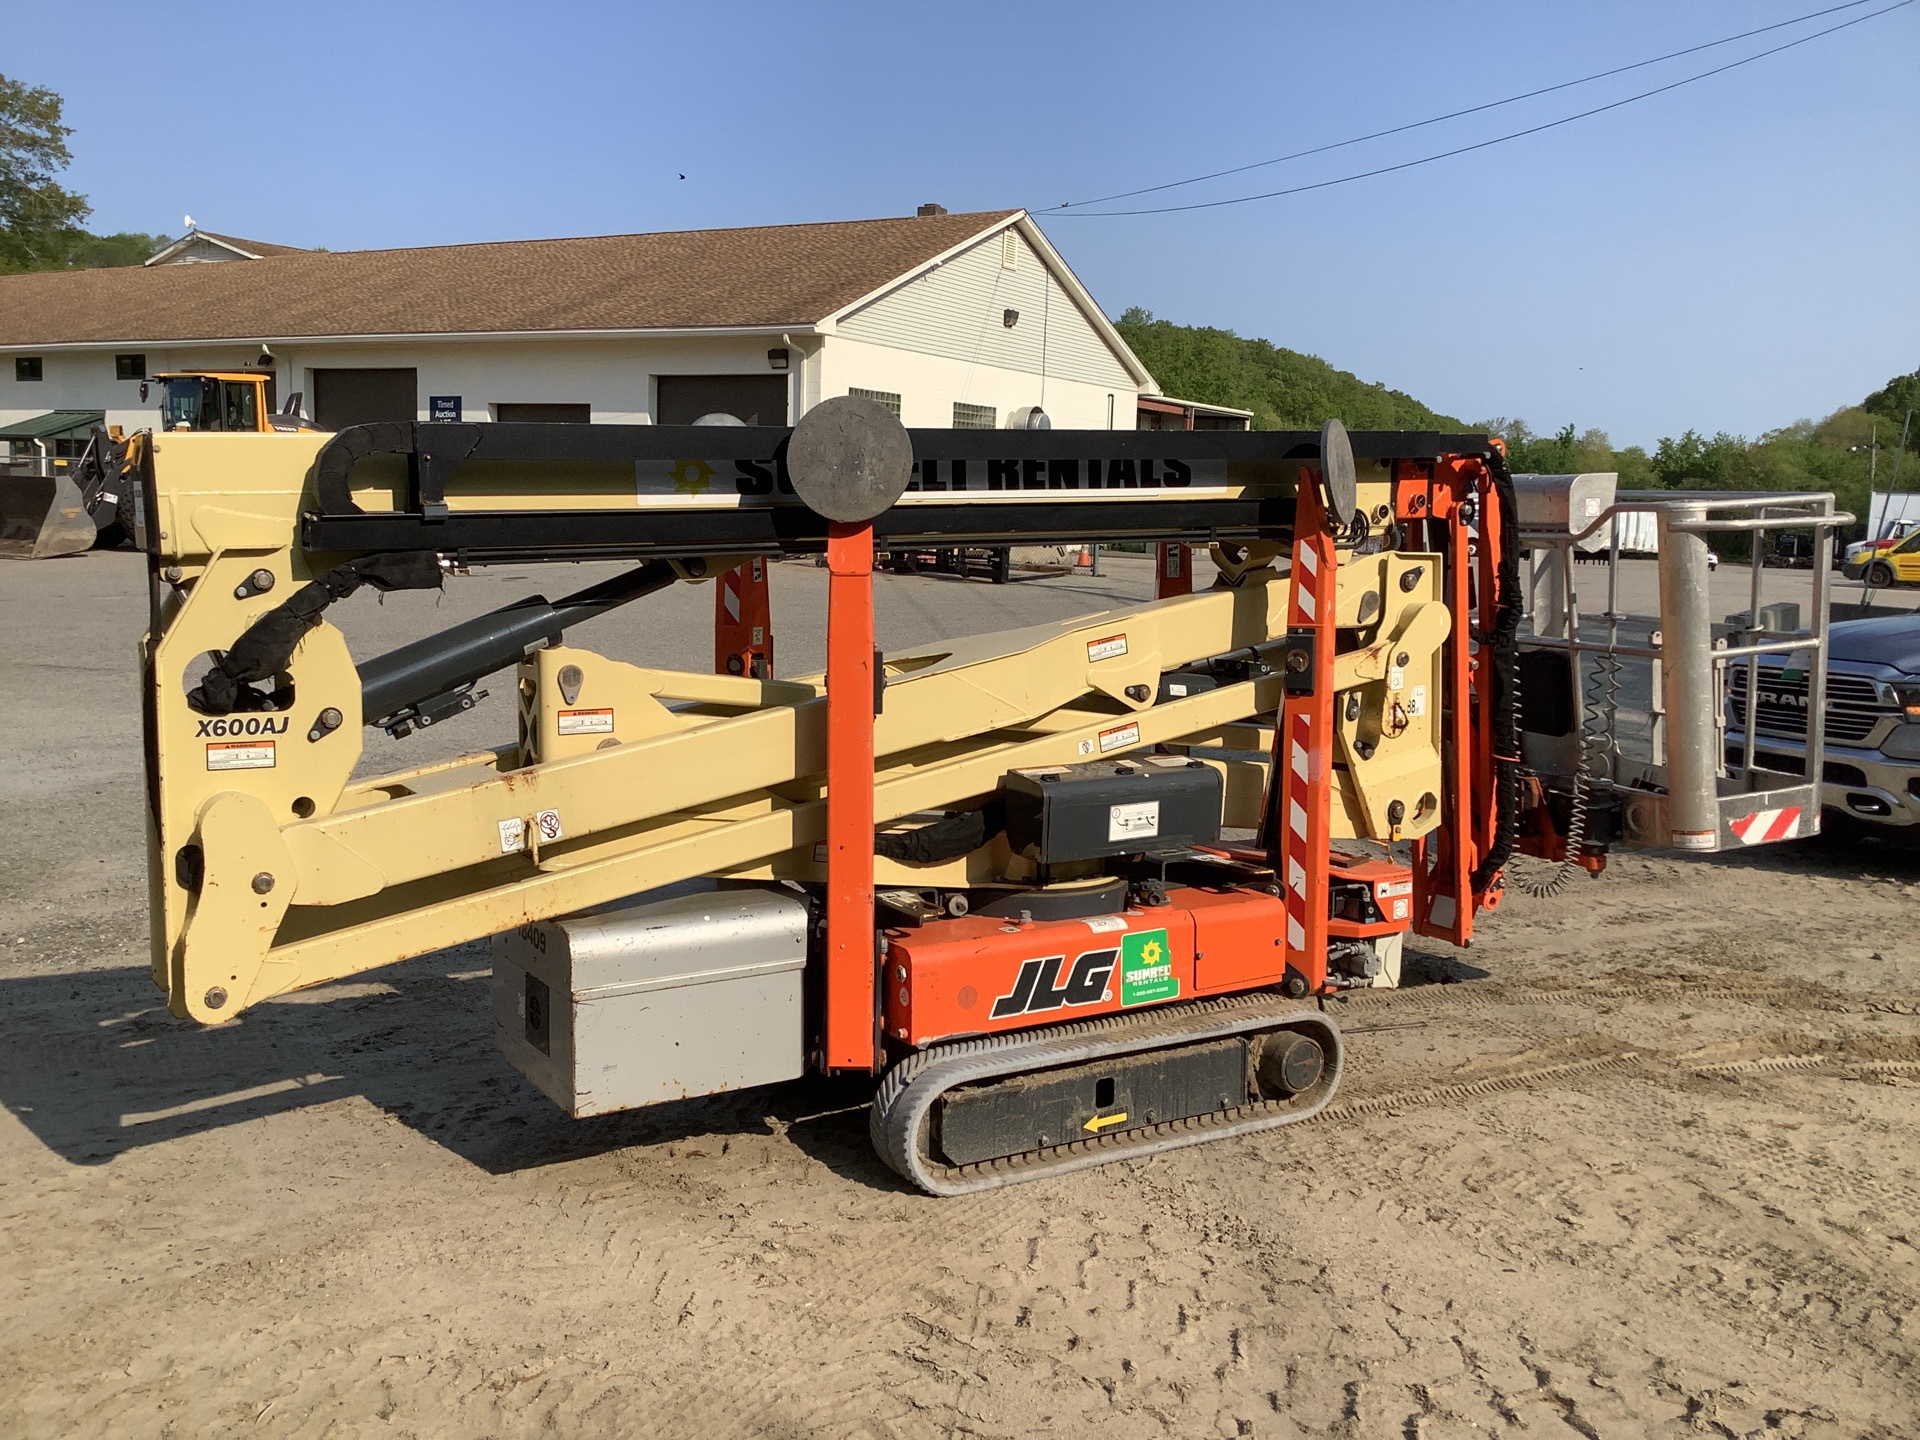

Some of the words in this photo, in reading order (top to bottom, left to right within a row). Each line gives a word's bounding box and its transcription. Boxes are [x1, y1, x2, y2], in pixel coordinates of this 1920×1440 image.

[437, 400, 454, 408] Timed
[435, 410, 457, 418] Auction
[195, 716, 290, 738] X600AJ
[988, 947, 1121, 1020] JLG
[1132, 976, 1169, 987] RENTALS
